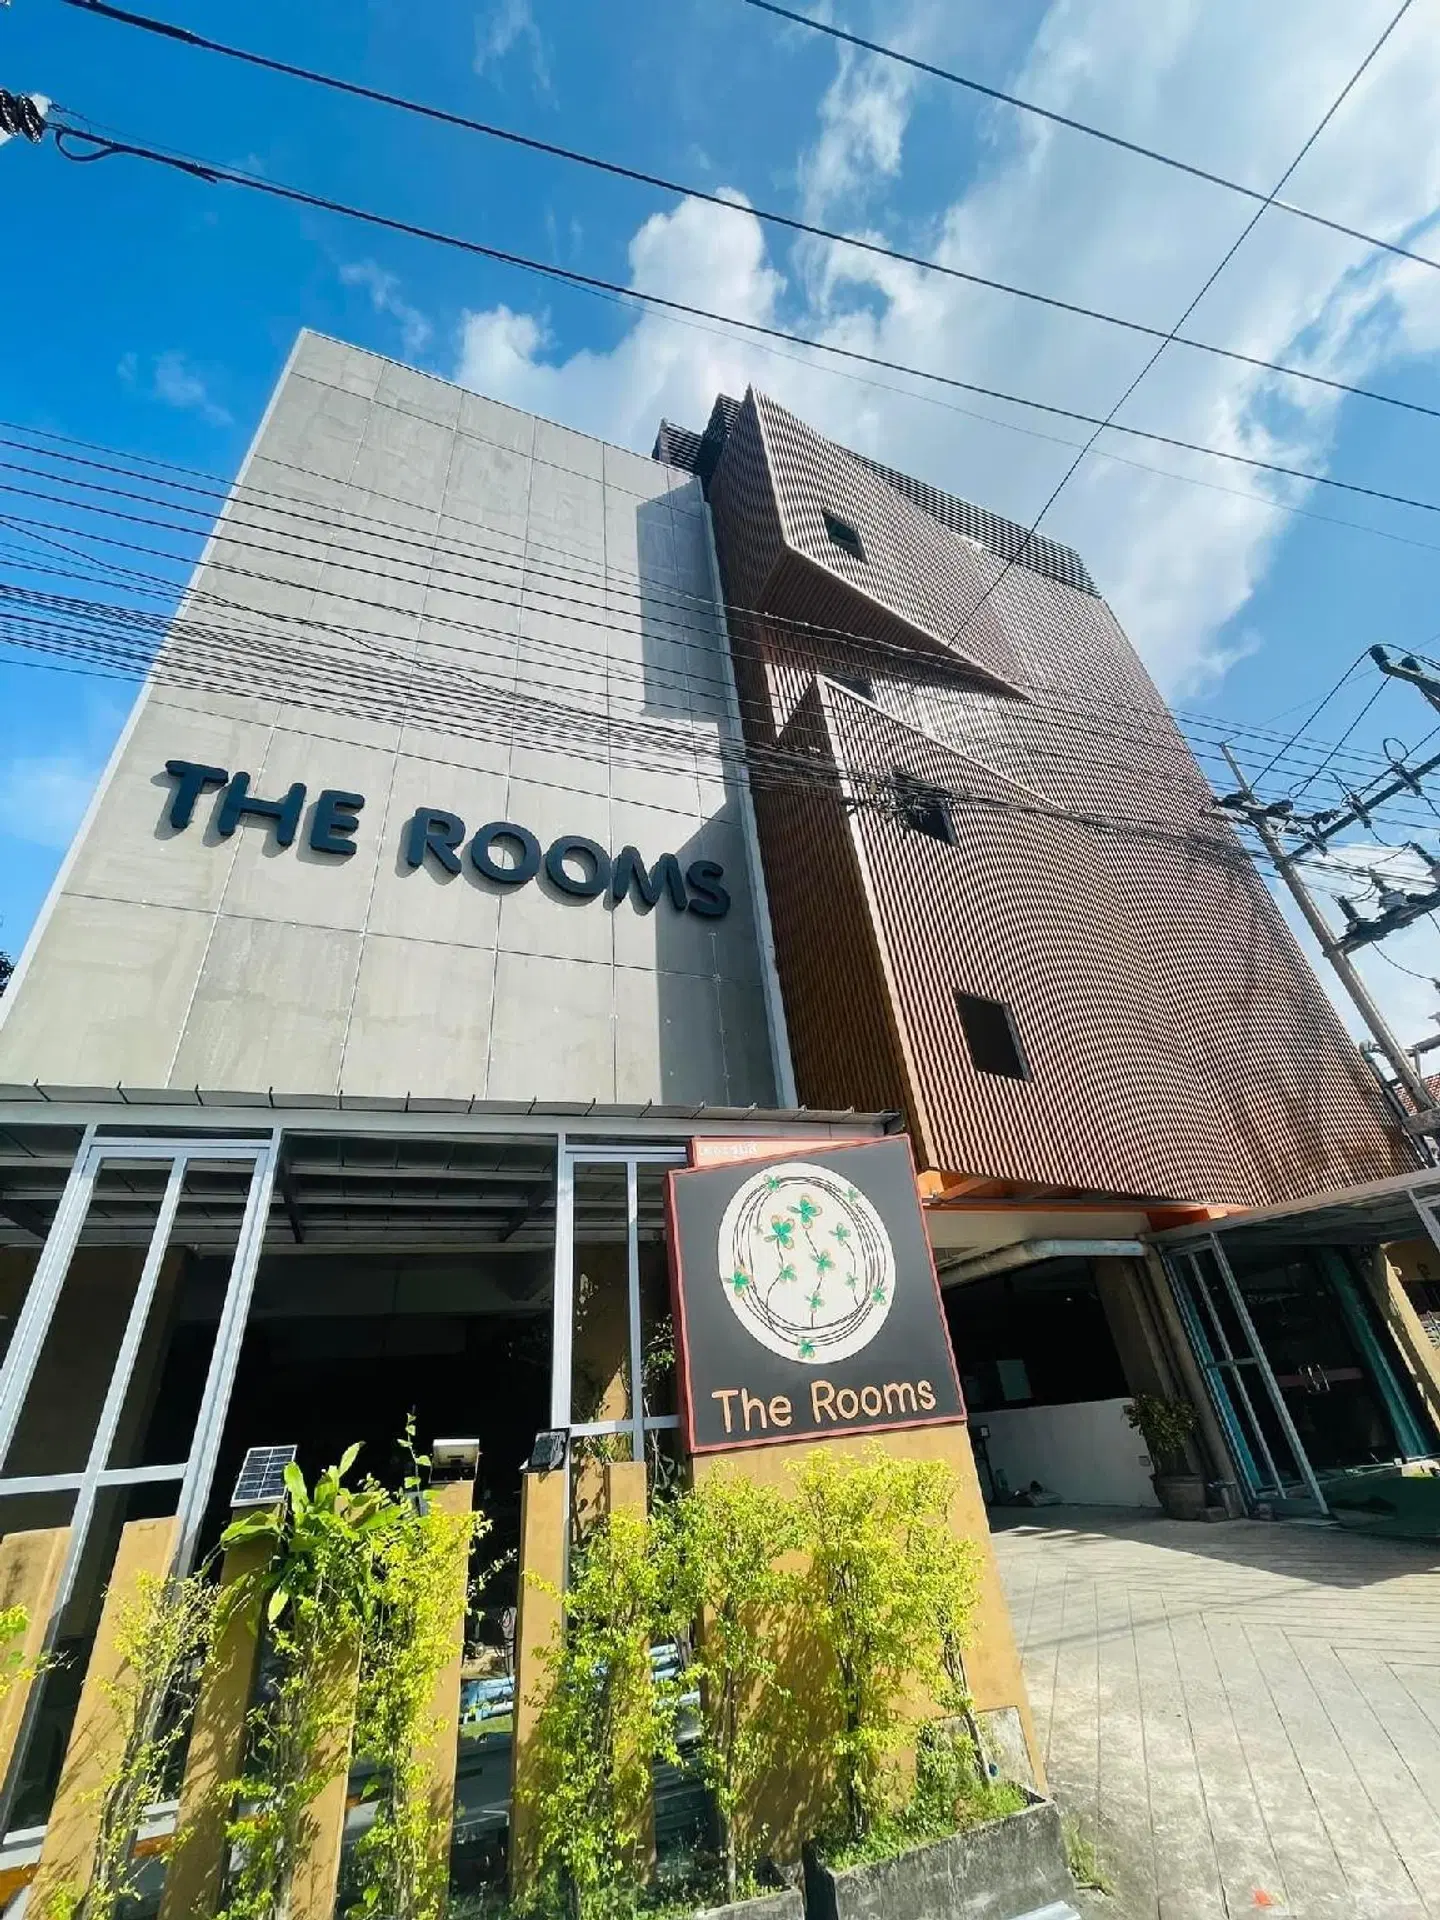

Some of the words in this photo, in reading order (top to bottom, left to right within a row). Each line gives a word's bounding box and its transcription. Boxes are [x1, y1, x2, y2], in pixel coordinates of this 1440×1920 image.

[165, 759, 365, 856] THE
[406, 807, 731, 918] ROOMS
[711, 1388, 792, 1433] The
[810, 1379, 937, 1424] Rooms
